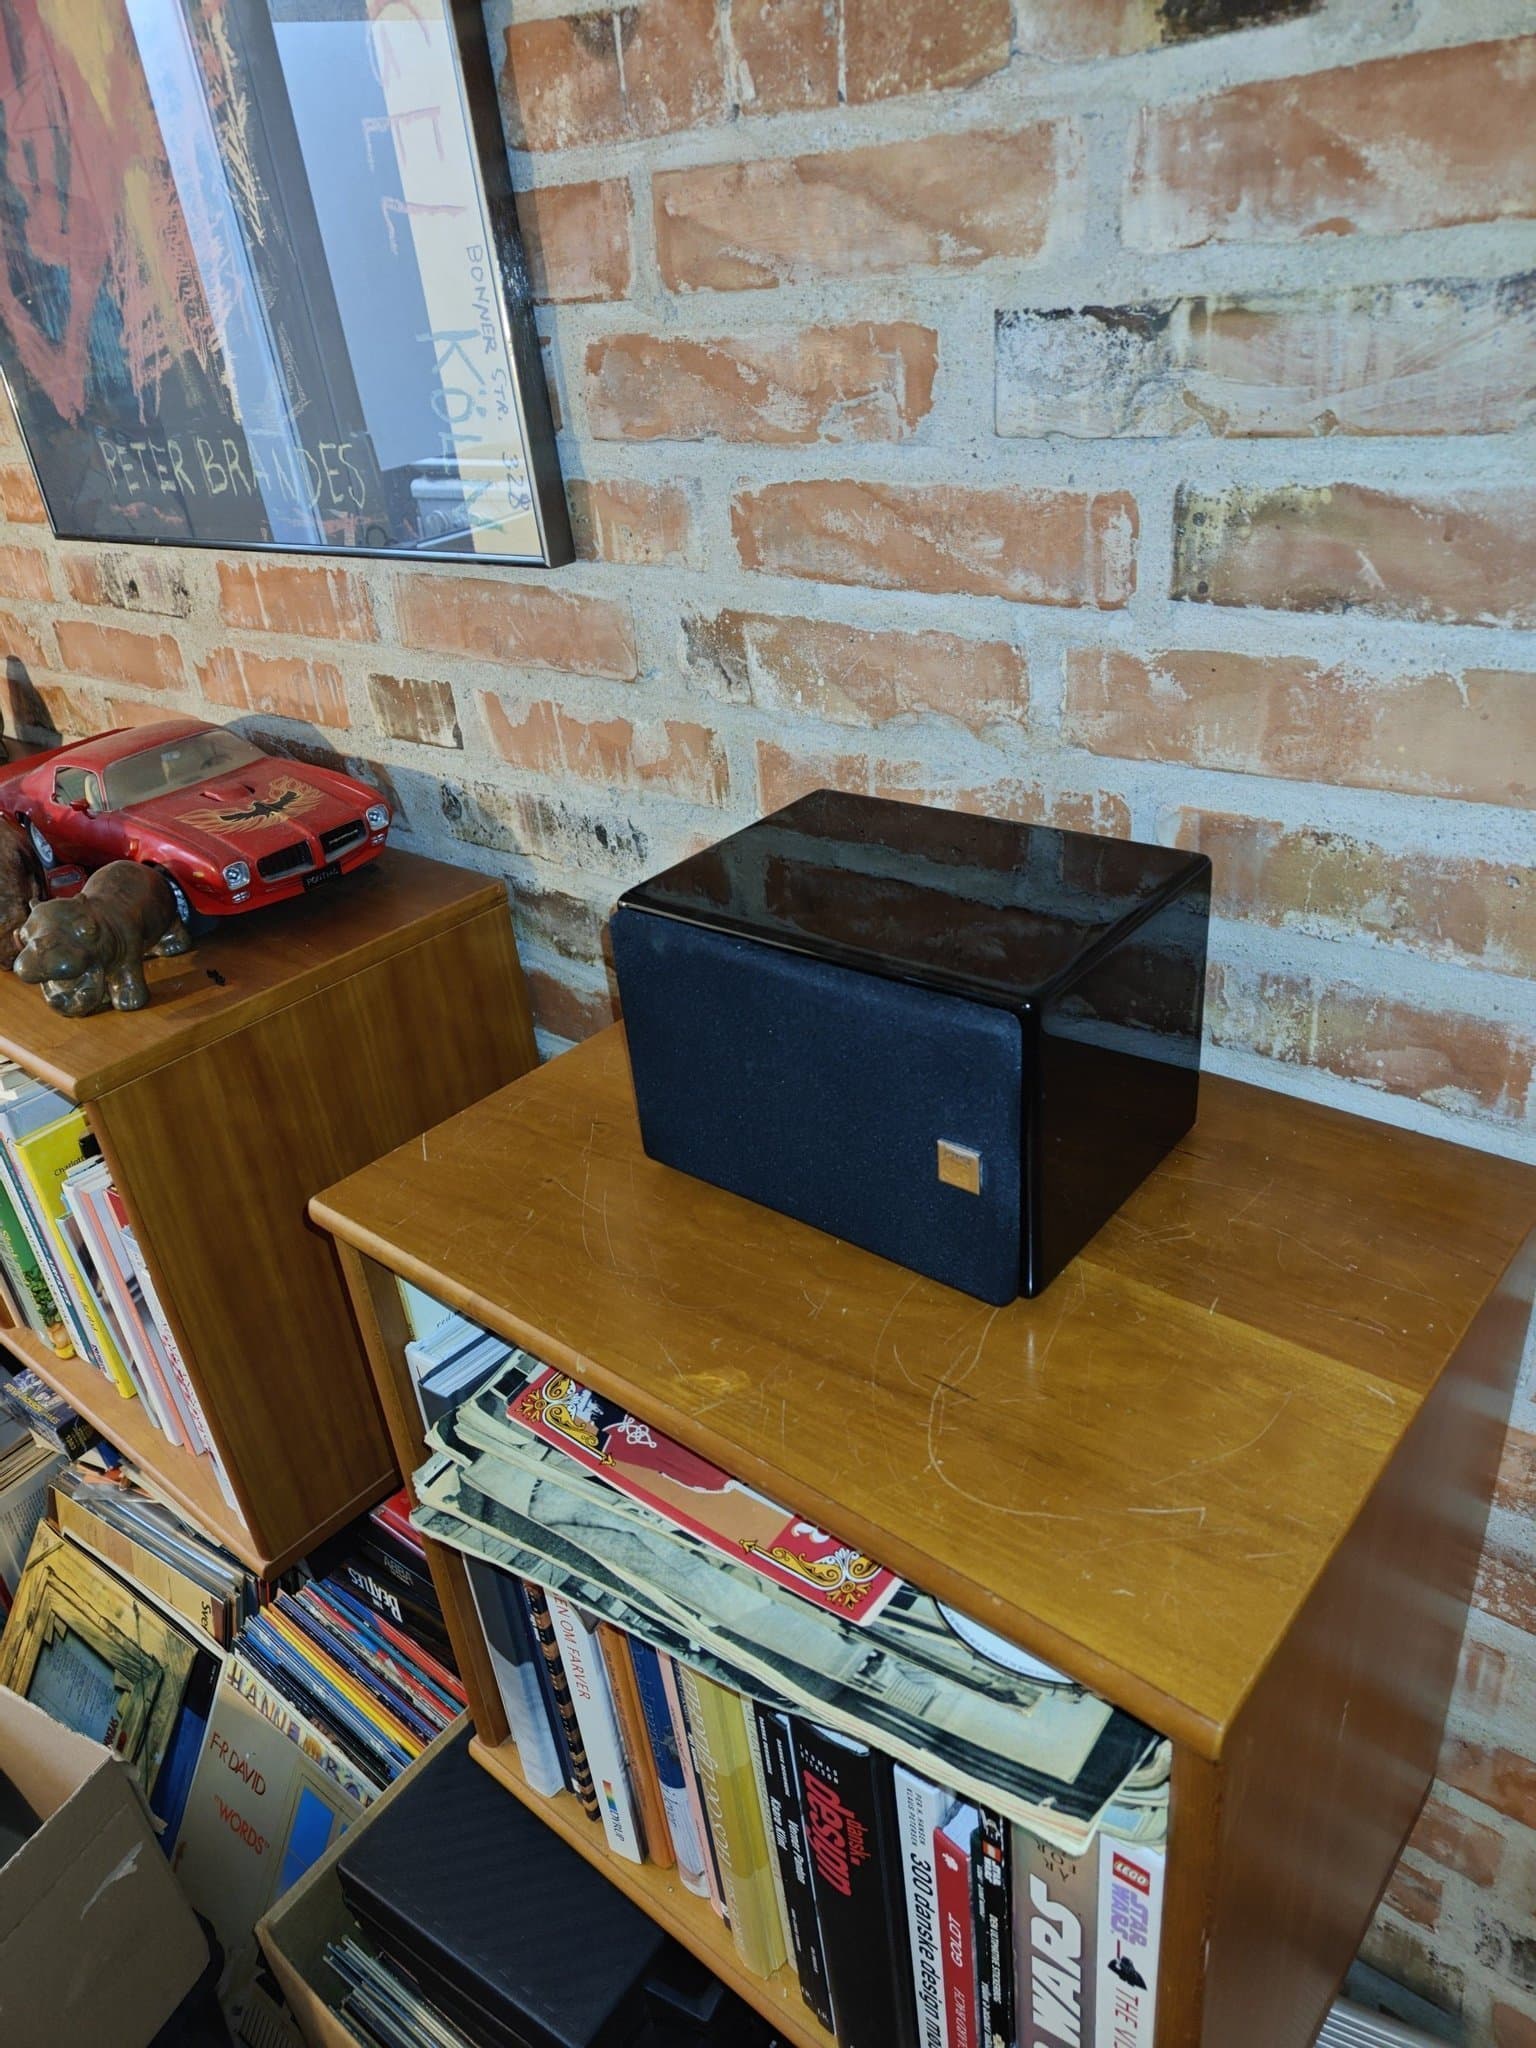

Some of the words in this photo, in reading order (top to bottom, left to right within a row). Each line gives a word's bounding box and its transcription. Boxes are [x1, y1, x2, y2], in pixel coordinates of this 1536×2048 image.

[465, 243, 498, 355] BONNER
[489, 366, 509, 423] STR.
[501, 450, 532, 511] 328
[415, 329, 505, 534] KÖLN
[98, 438, 197, 497] PETER
[196, 436, 367, 511] BRANDES
[347, 1567, 404, 1624] BEATLES
[559, 1616, 577, 1646] OM
[567, 1638, 592, 1702] FARVER
[227, 1751, 267, 1797] DAVID
[906, 1787, 916, 1812] KLAUS
[802, 1768, 853, 1897] design
[848, 1817, 872, 1860] dansk
[908, 1812, 918, 1847] PETERSEN
[917, 1816, 926, 1846] HANSEN
[910, 1852, 934, 1897] 300
[1113, 1860, 1149, 1888] LEGO
[914, 1892, 939, 1961] danske
[947, 1911, 964, 1968] GOLDT
[1109, 1882, 1133, 1941] WARS
[1127, 1888, 1150, 1949] STAR
[1029, 1872, 1082, 2048] WARS
[919, 1958, 943, 2021] design
[1114, 1986, 1140, 2030] THE
